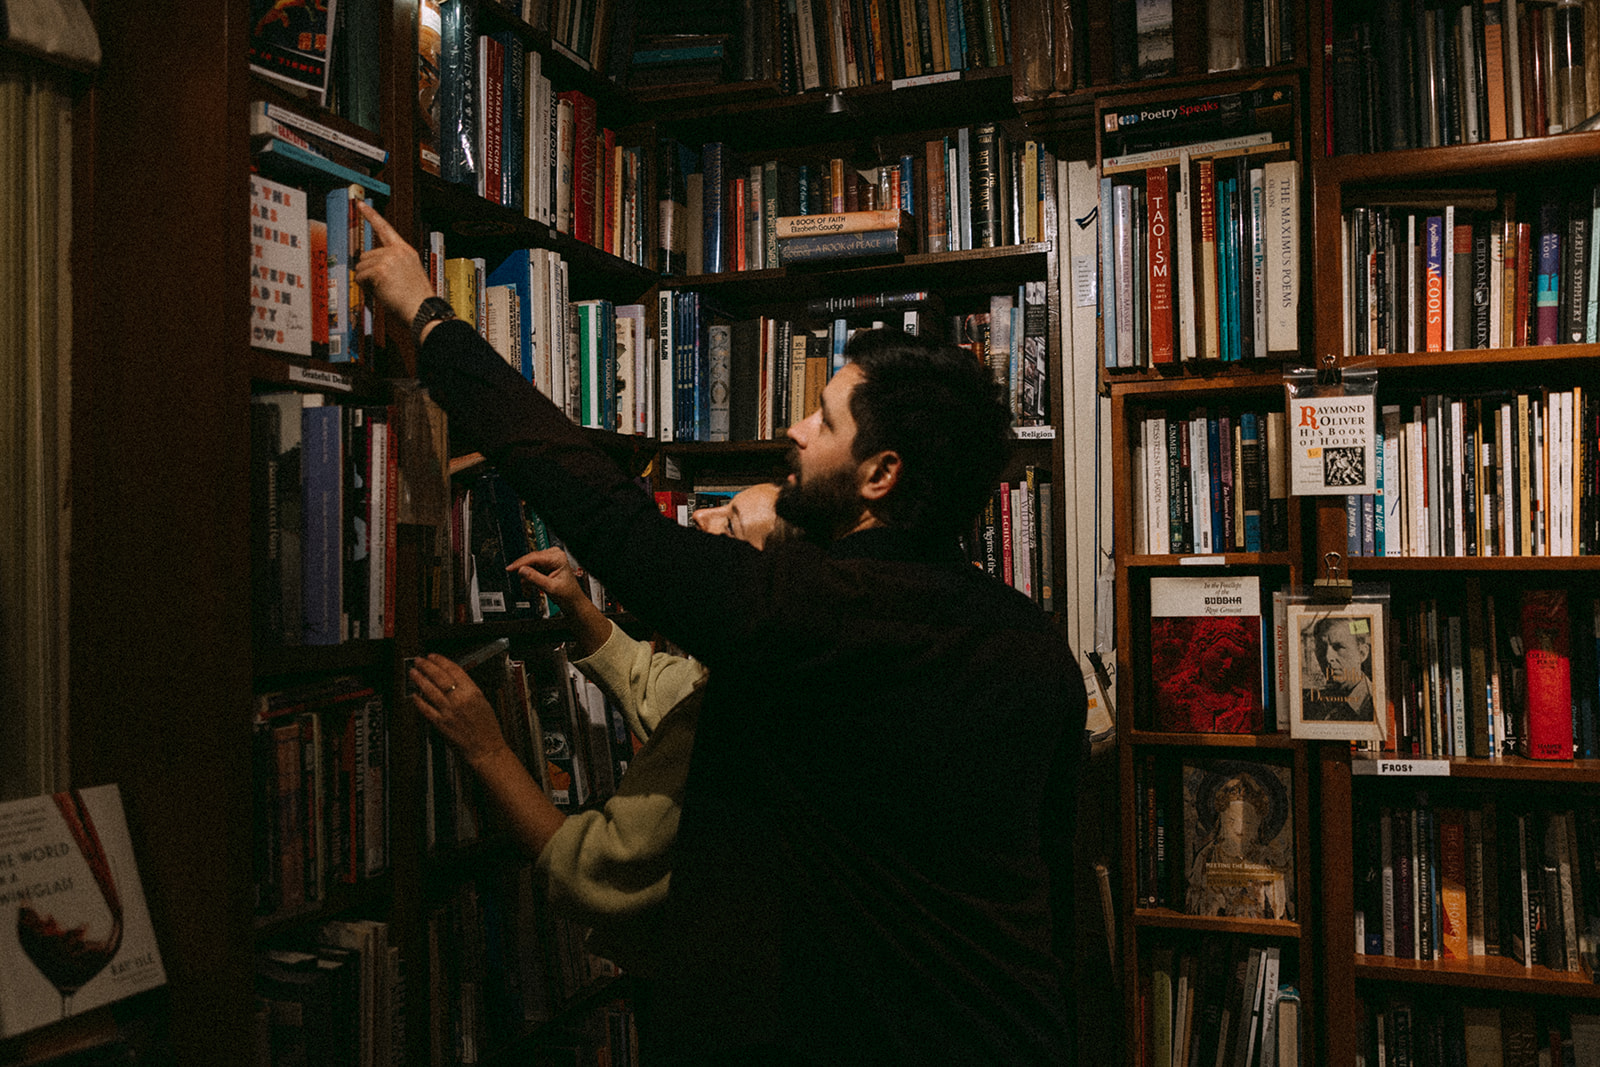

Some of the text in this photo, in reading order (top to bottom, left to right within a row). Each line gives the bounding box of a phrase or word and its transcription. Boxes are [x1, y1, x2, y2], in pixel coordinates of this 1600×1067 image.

[1140, 100, 1219, 121] Poetry Speaks
[487, 77, 495, 171] NATASHA'S KITCHEN
[493, 82, 502, 176] NATASHA'S KITCHEN
[976, 150, 990, 210] BELL CURVE
[989, 172, 997, 188] THE
[1268, 179, 1276, 208] OLSON
[791, 223, 843, 233] Elizabeth Goudge
[1152, 197, 1168, 277] TAOISM
[855, 239, 881, 249] PEACE
[1280, 179, 1292, 308] THE MAXIMUS POEMS
[1427, 223, 1440, 324] Apollinaire ALCOOLS
[1572, 220, 1584, 322] FEARFUL SYMMETRY
[301, 369, 331, 382] Grateful
[604, 358, 613, 400] COOKBOOK
[1298, 405, 1366, 430] RAYMOND
[1320, 415, 1366, 426] OLIVER
[1021, 430, 1053, 439] Religion
[1300, 427, 1366, 437] HIS BOOK
[1320, 437, 1366, 447] HOURS
[1154, 478, 1163, 503] GARDEN
[983, 526, 996, 573] Pilgrims of the
[1204, 596, 1243, 605] BUDDHA
[20, 842, 70, 864] WORLD
[1231, 862, 1242, 870] THE
[1448, 902, 1460, 943] HOMER
